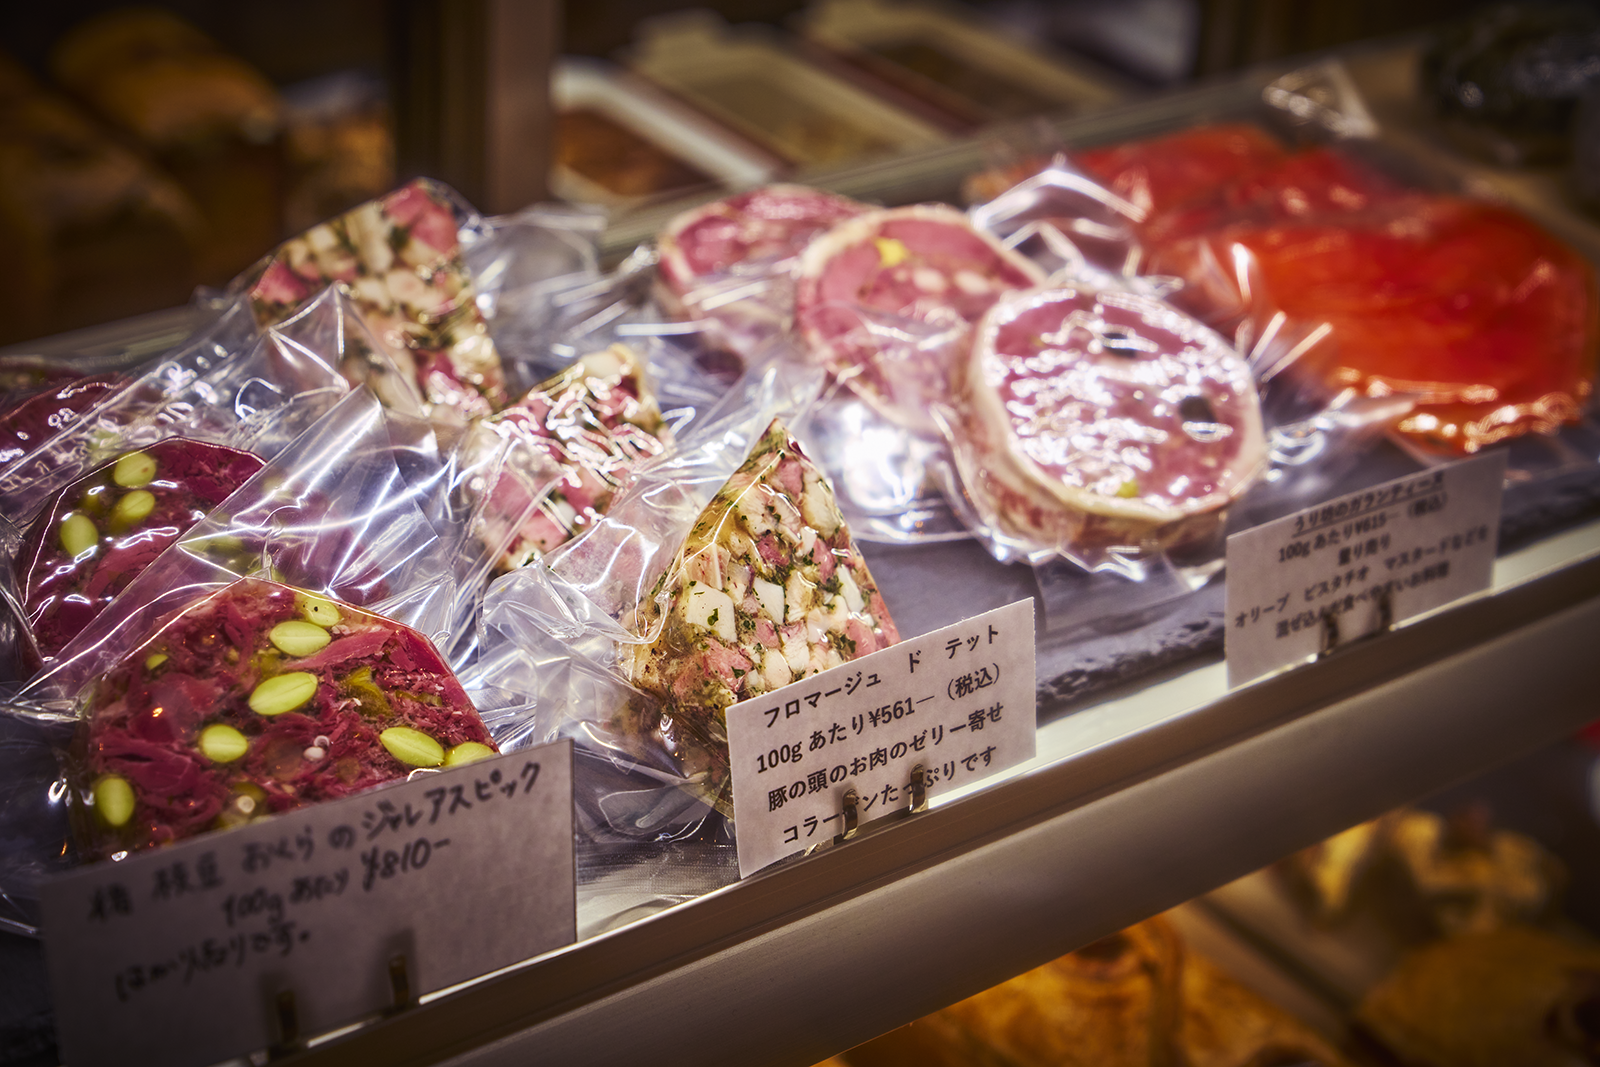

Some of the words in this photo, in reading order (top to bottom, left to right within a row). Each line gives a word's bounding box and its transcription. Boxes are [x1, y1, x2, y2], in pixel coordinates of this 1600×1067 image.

[763, 671, 882, 728] フロマージュ
[908, 649, 922, 674] ド
[944, 624, 999, 660] テット
[767, 702, 1005, 813] 豚の頭のお肉のゼリー寄せ
[782, 744, 998, 844] コラーンたっぷりです
